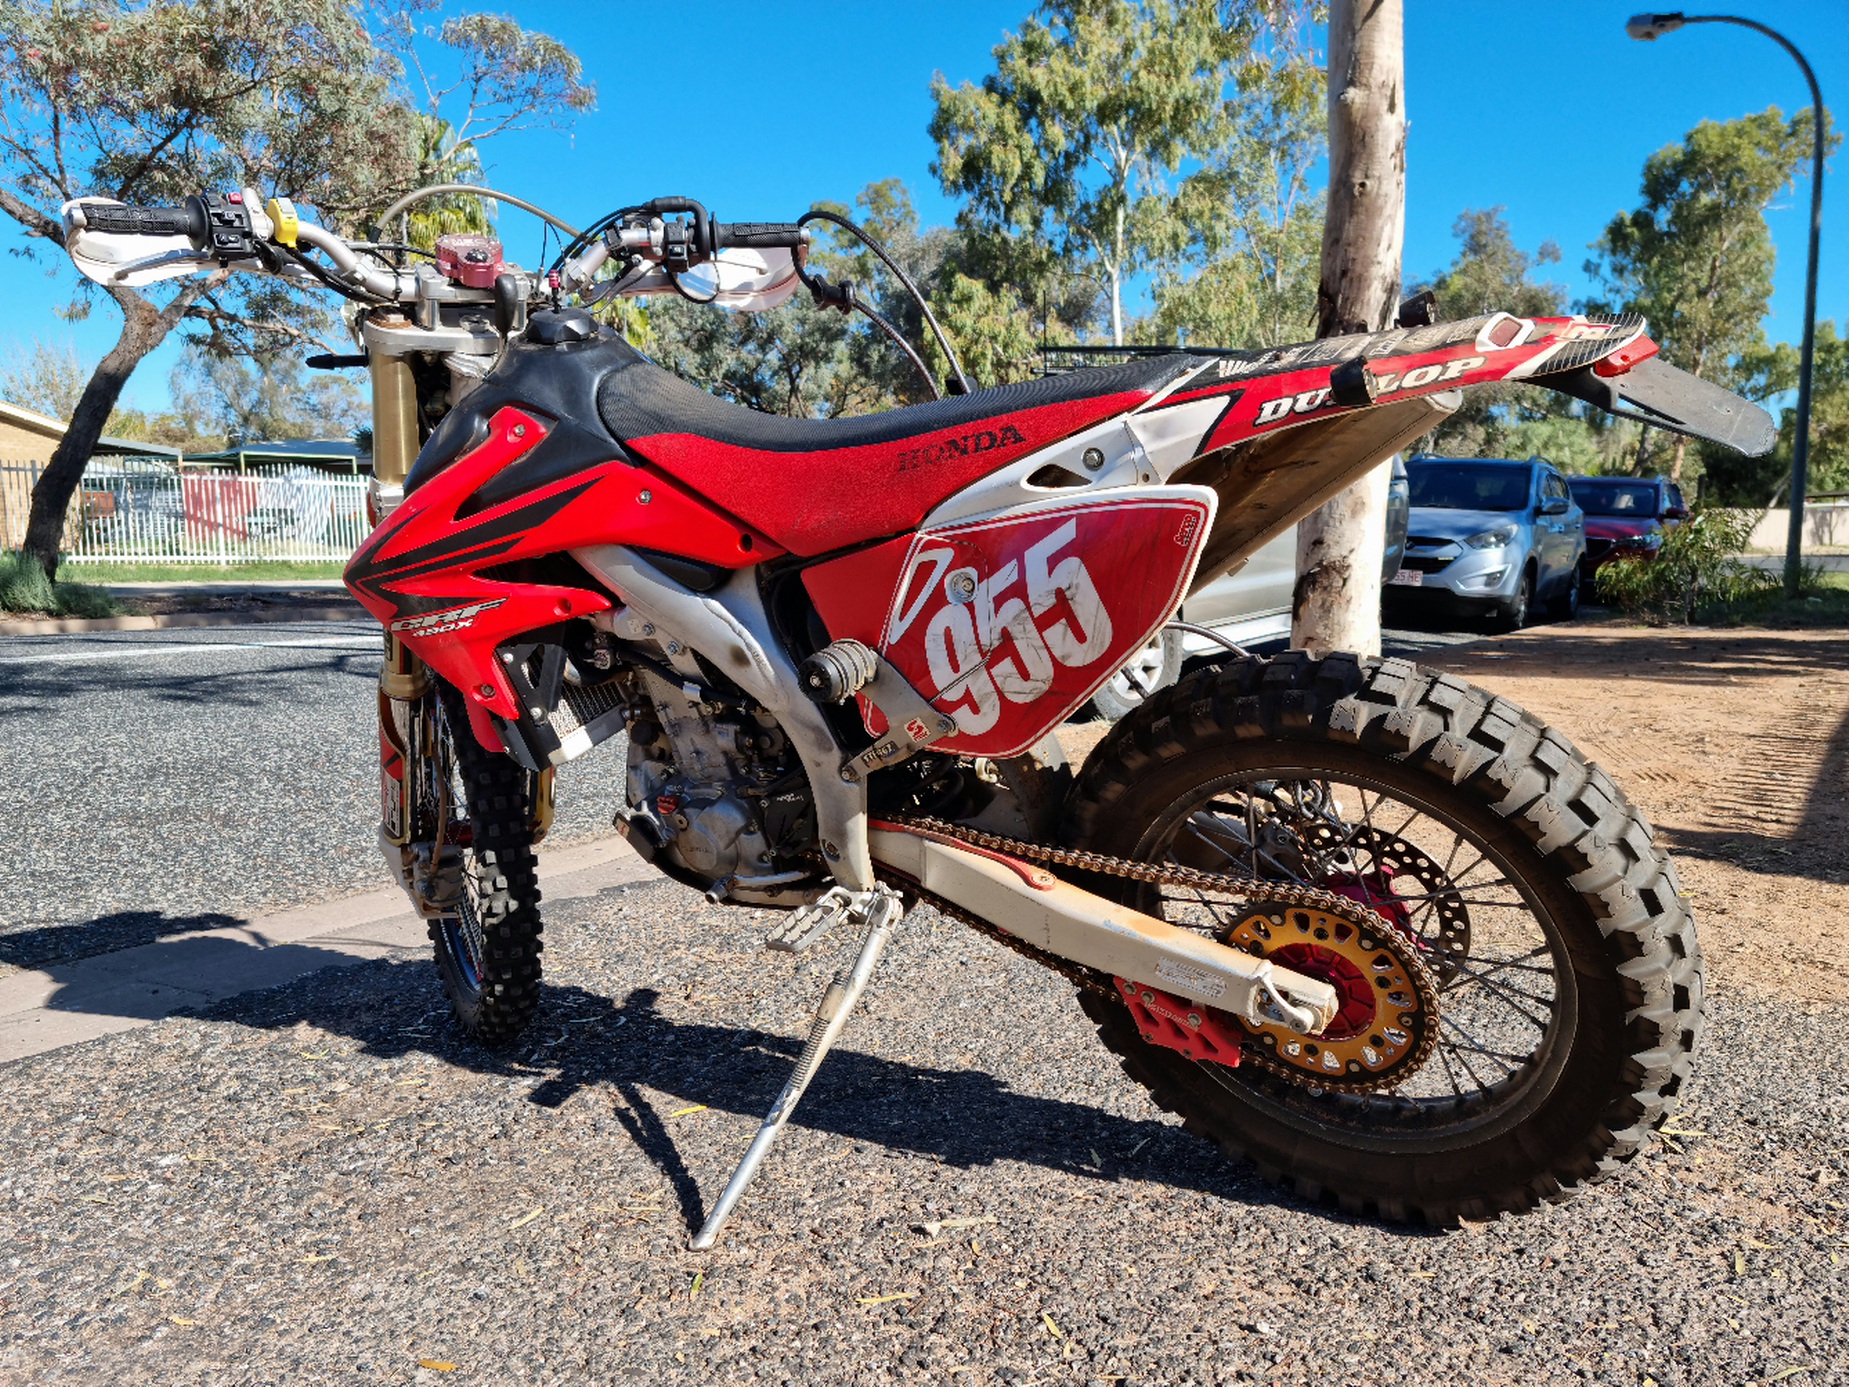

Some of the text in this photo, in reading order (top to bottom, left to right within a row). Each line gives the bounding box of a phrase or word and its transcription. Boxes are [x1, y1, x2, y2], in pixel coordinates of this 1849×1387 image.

[1255, 356, 1486, 425] DULOP
[898, 424, 1026, 471] HONDA
[391, 597, 507, 631] CRF
[924, 517, 1114, 736] 955
